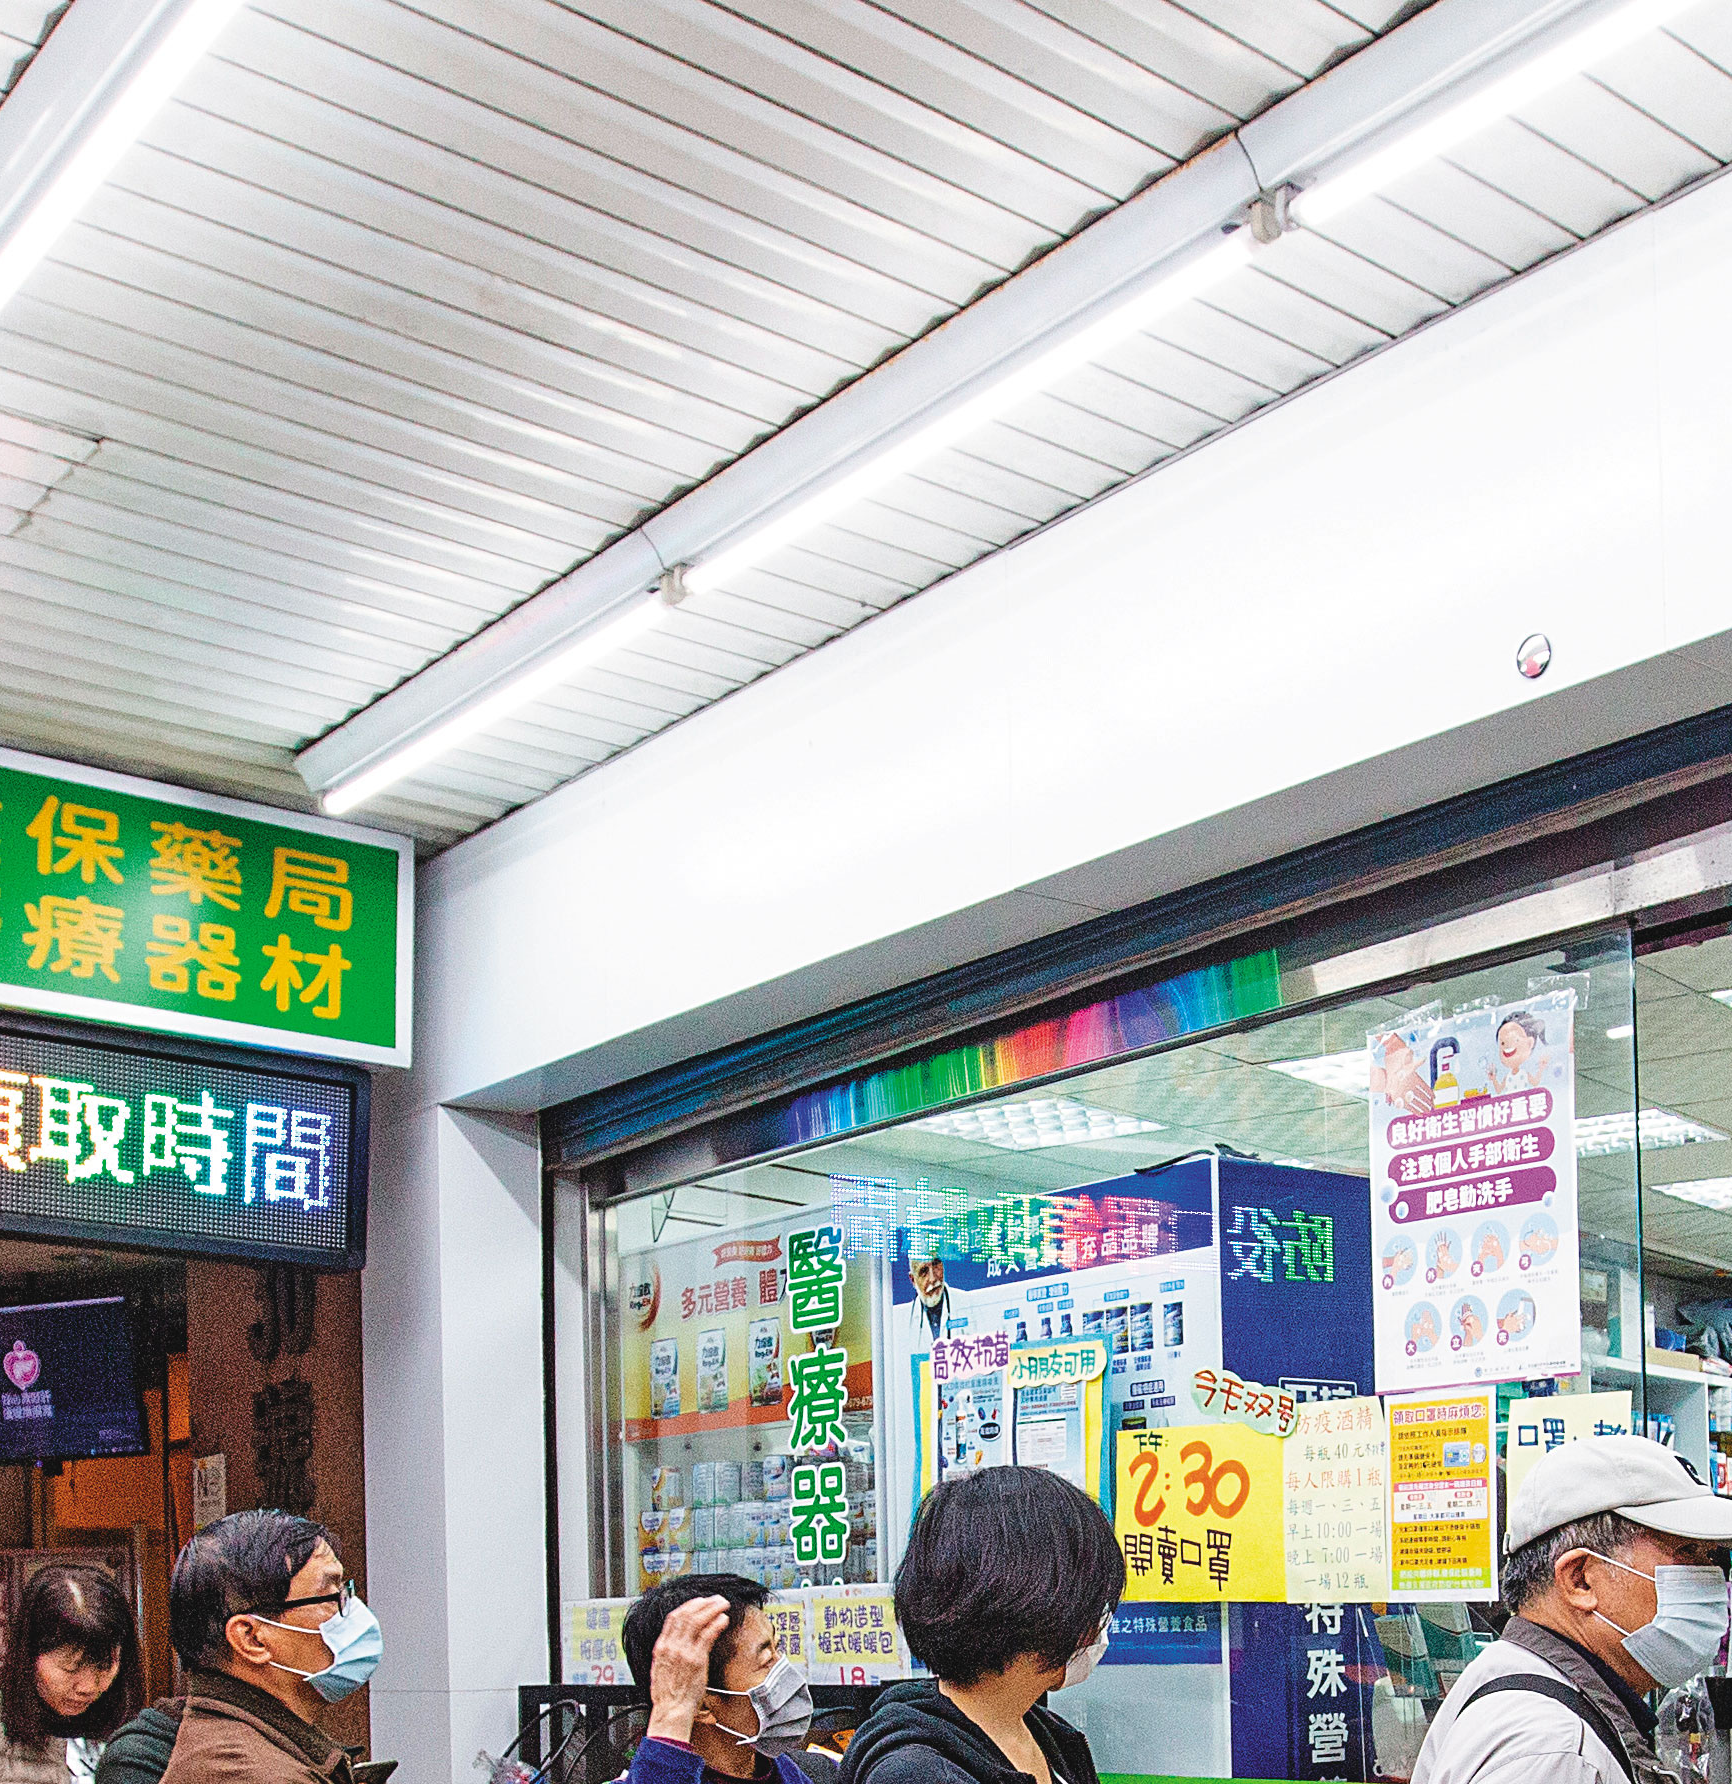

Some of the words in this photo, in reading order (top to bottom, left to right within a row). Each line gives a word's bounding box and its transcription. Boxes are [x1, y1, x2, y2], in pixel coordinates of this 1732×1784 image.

[1390, 1092, 1548, 1147] 良好衛生習慣好重要
[1400, 1133, 1541, 1182] 注意個人手部衛生
[1425, 1176, 1514, 1215] 肥皂勤洗手
[681, 1277, 747, 1320] 多元營養
[932, 1330, 1009, 1380] 高效抗菌
[1010, 1349, 1096, 1380] 小朋友可用
[788, 1225, 849, 1588] 醫療器
[1296, 1406, 1374, 1435] 防疫酒精
[1129, 1442, 1250, 1528] 2:30
[1122, 1526, 1233, 1592] 開賣口罩
[824, 1605, 884, 1629] 動物造型
[1305, 1603, 1349, 1782] 特殊營
